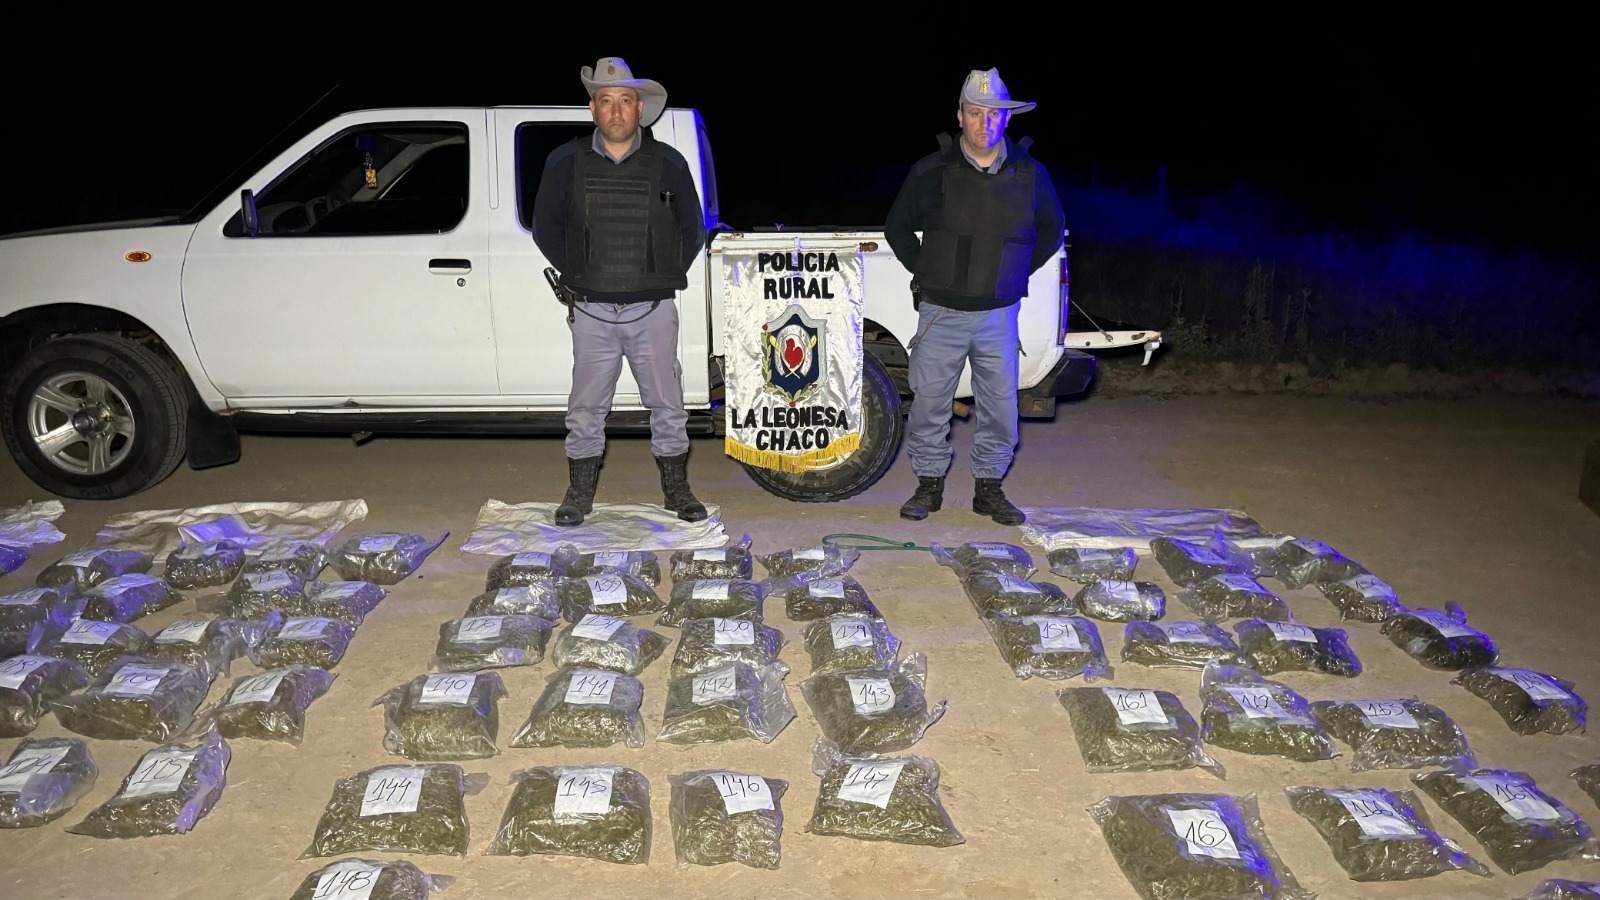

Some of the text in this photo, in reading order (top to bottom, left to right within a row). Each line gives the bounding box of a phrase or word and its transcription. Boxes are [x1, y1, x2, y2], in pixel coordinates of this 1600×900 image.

[758, 252, 840, 273] POLICIA
[764, 277, 835, 300] RURAL
[731, 406, 848, 430] LA LEONESA
[756, 429, 830, 450] CHACO
[427, 676, 468, 695] 140
[569, 675, 610, 697] 141
[699, 676, 736, 695] 142
[858, 685, 892, 706] 143
[1116, 691, 1148, 712] 161
[558, 776, 607, 798] 145
[722, 774, 761, 798] 146
[845, 766, 890, 790] 147
[366, 777, 412, 803] 144
[1185, 819, 1228, 848] 165
[313, 870, 374, 899] 148
